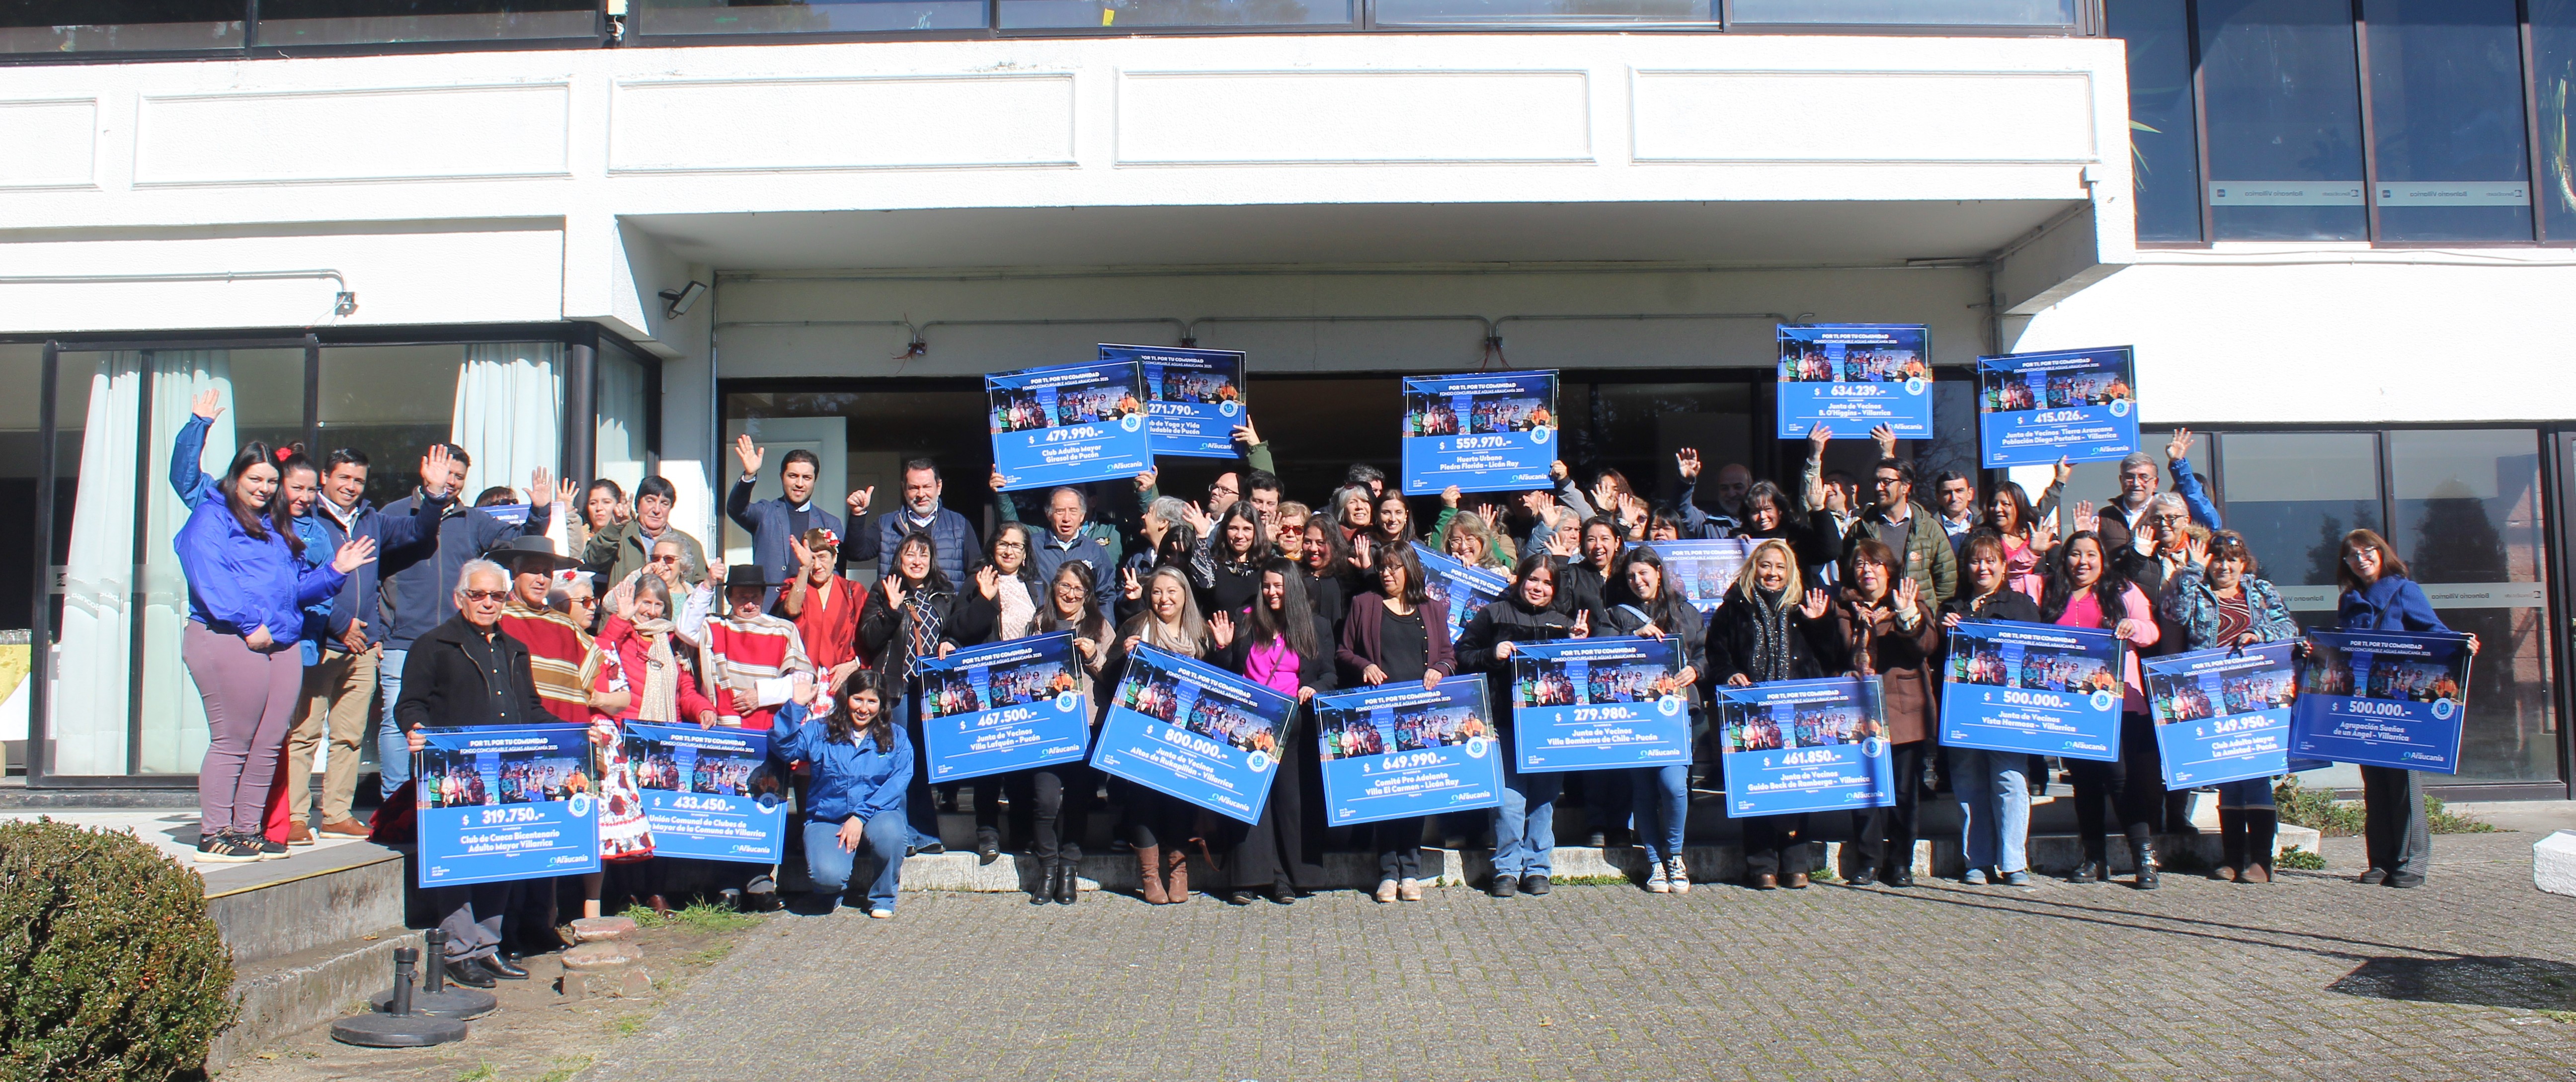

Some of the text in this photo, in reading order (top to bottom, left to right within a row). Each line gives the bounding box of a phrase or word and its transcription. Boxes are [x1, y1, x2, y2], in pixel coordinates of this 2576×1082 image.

[1046, 426, 1103, 441] 479.990.-
[1080, 445, 1101, 454] Mayor
[1456, 436, 1512, 449] 559.970.-
[1046, 454, 1069, 463] Girasol
[1178, 667, 1191, 676] POR
[1198, 675, 1210, 683] POR
[1218, 682, 1251, 698] COMUNIDAD
[1574, 707, 1637, 721] 279.980.-
[2349, 701, 2412, 717] 500.000.-
[977, 708, 1037, 726] 467.500.-
[2031, 714, 2060, 723] Vecinos
[2002, 719, 2034, 728] Hermosa
[2042, 723, 2076, 732] Villarrica
[2340, 722, 2405, 733] Agrupación Sueños
[986, 739, 1014, 749] Lafquén
[1019, 735, 1040, 743] Pucón
[2378, 732, 2410, 741] Villarrica
[1048, 744, 1079, 754] Araucanía
[1165, 729, 1227, 759] 800.000.-
[1156, 748, 1177, 760] Junta
[1188, 758, 1214, 773] Vecinos
[1383, 752, 1447, 770] 649.990.-
[2411, 752, 2444, 761] Araucanía
[1130, 747, 1149, 758] Altos
[1160, 756, 1197, 775] Rukapillán
[1204, 771, 1233, 788] Villarrica
[1375, 777, 1401, 787] Comité
[1416, 772, 1448, 782] Adelanto
[673, 797, 735, 812] 433.450.-
[1218, 795, 1249, 812] Araucanía
[482, 807, 545, 824] 319.750.-
[671, 816, 703, 825] Comunal
[460, 835, 478, 844] Club
[479, 834, 489, 843] de
[513, 830, 560, 840] Bicentenario
[652, 824, 675, 833] Mayor
[695, 826, 724, 834] Comuna
[735, 829, 766, 837] Villarrica
[469, 839, 553, 852] Adulto Mayor Villarrica
